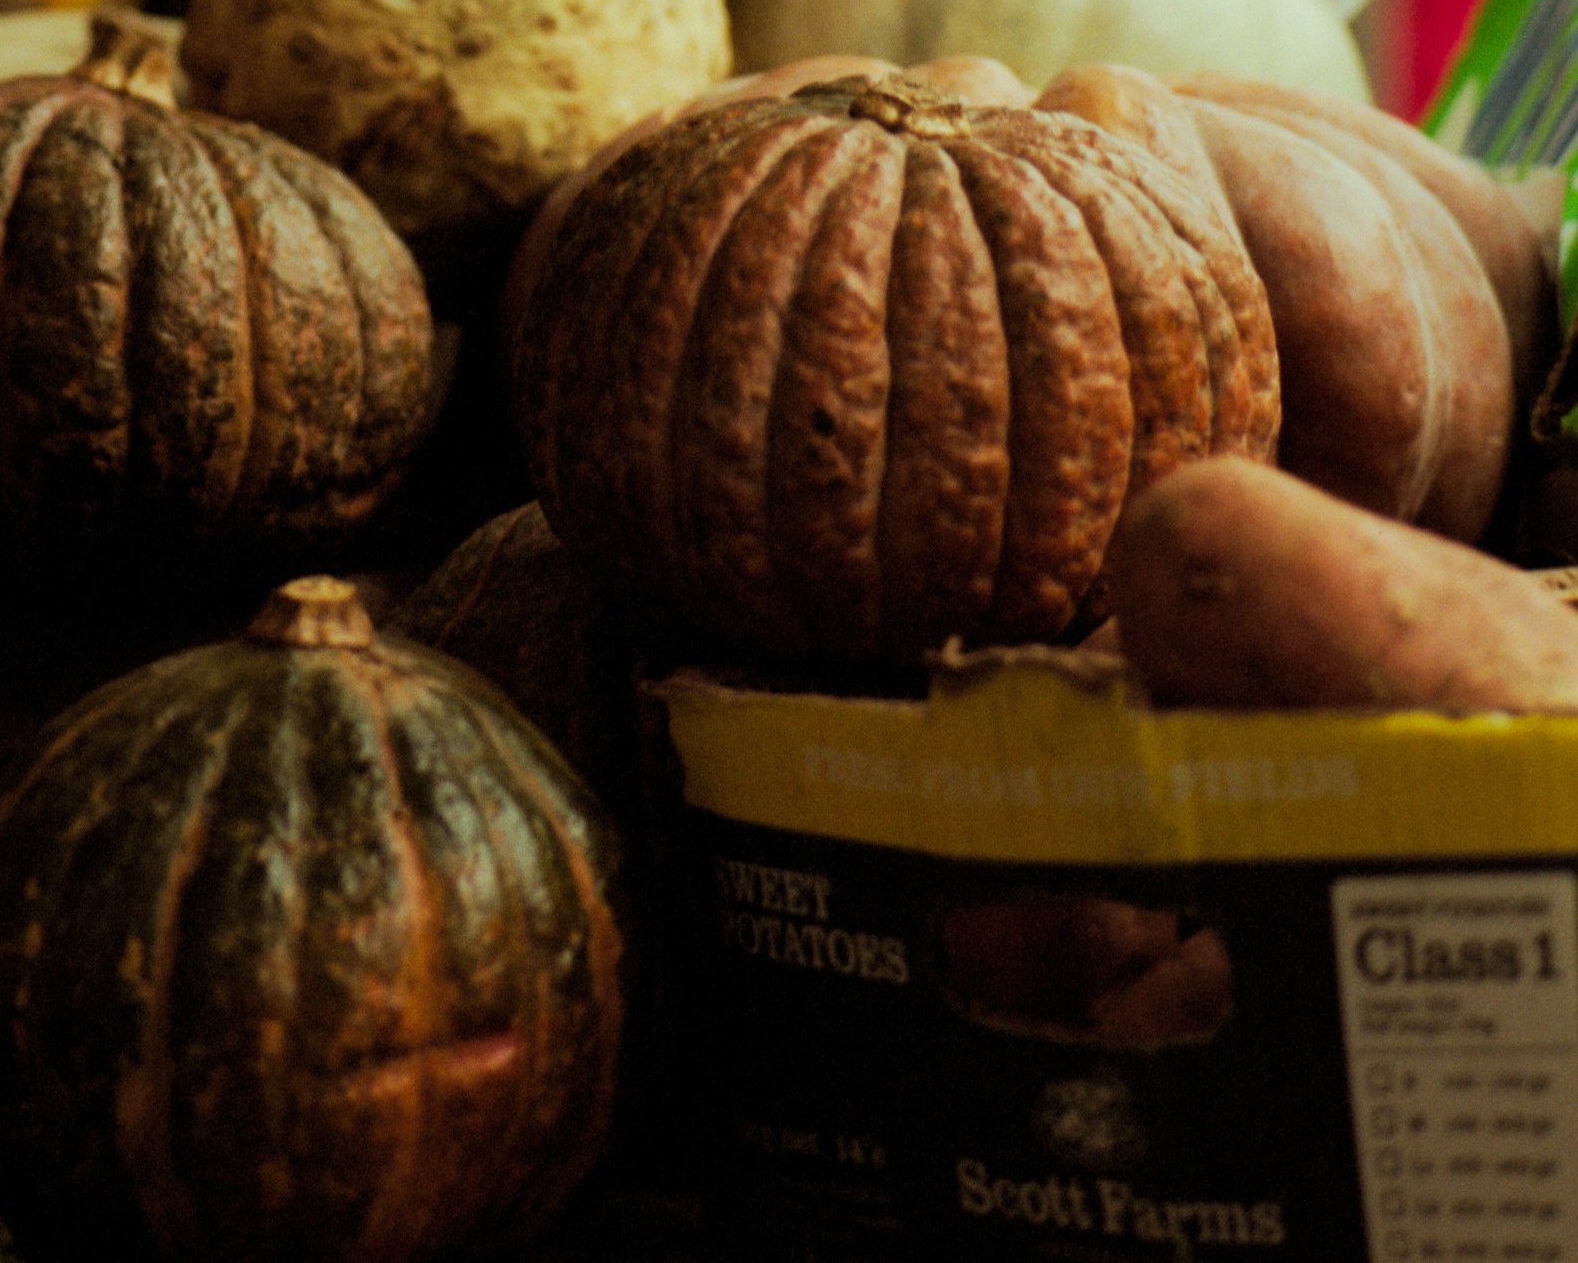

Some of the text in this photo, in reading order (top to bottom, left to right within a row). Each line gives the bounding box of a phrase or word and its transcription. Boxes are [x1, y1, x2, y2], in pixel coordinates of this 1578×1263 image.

[1167, 753, 1362, 804] FIELDS
[1353, 926, 1560, 985] Class 1
[956, 1157, 1093, 1231] Scott
[1095, 1178, 1286, 1246] Farms
